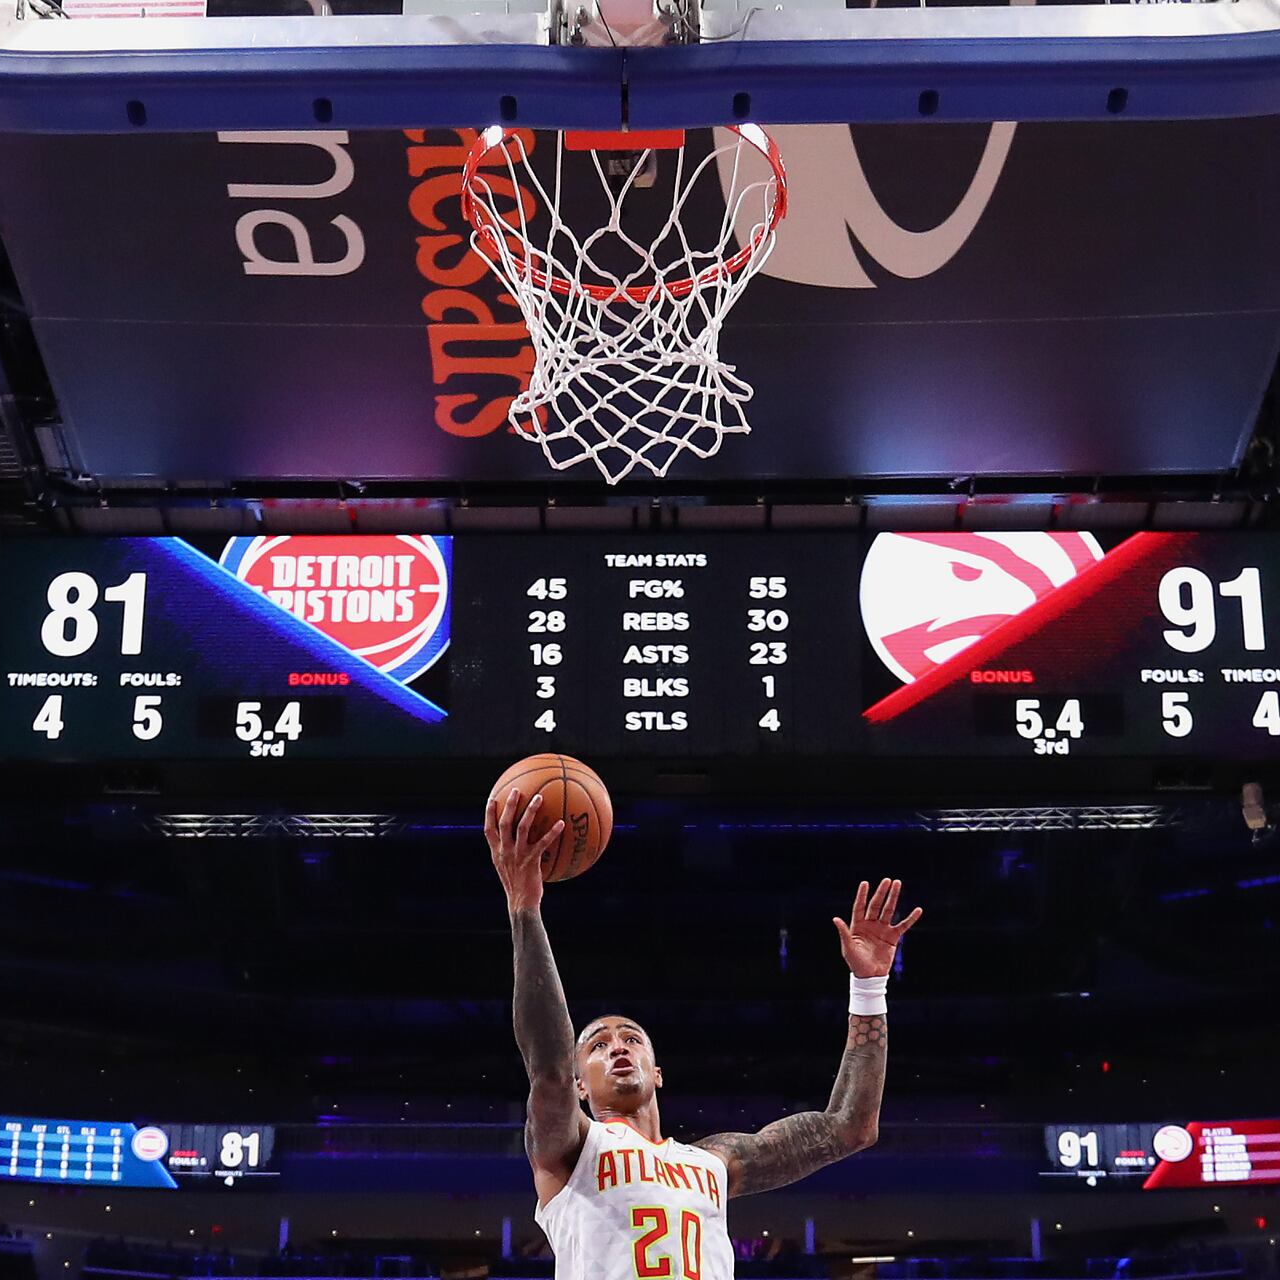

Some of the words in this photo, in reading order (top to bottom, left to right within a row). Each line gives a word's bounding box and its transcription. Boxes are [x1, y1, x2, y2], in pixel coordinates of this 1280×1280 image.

[270, 555, 415, 588] DETROIT
[605, 554, 653, 567] TEAM
[656, 554, 707, 567] STATS
[527, 577, 568, 600] 45
[628, 578, 684, 600] FG%
[748, 577, 788, 599] 55
[40, 571, 147, 657] 81
[527, 610, 567, 633] 28
[623, 611, 689, 632] REBS
[747, 609, 789, 632] 30
[1158, 567, 1267, 652] 91
[531, 643, 563, 666] 16
[623, 643, 689, 664] ASTS
[748, 642, 788, 665] 23
[7, 673, 98, 687] TIMEOUTS:
[120, 673, 181, 687] FOULS:
[288, 672, 350, 686] BONUS
[536, 676, 555, 698] 3
[624, 676, 689, 698] BLKS
[761, 675, 775, 698] 1
[970, 669, 1033, 683] BONUS
[1140, 669, 1205, 684] FOULS:
[32, 694, 64, 740] 4
[132, 694, 163, 741] 5
[235, 701, 303, 742] 5.4
[534, 709, 557, 732] 4
[624, 710, 688, 732] STLS
[758, 708, 782, 732] 4
[1015, 699, 1085, 740] 5.4
[1162, 691, 1193, 737] 5
[249, 741, 285, 758] 3rd
[1033, 738, 1069, 755] 3rd
[220, 1131, 260, 1167] 81
[1058, 1131, 1099, 1167] 91
[596, 1148, 721, 1210] ATLANTA
